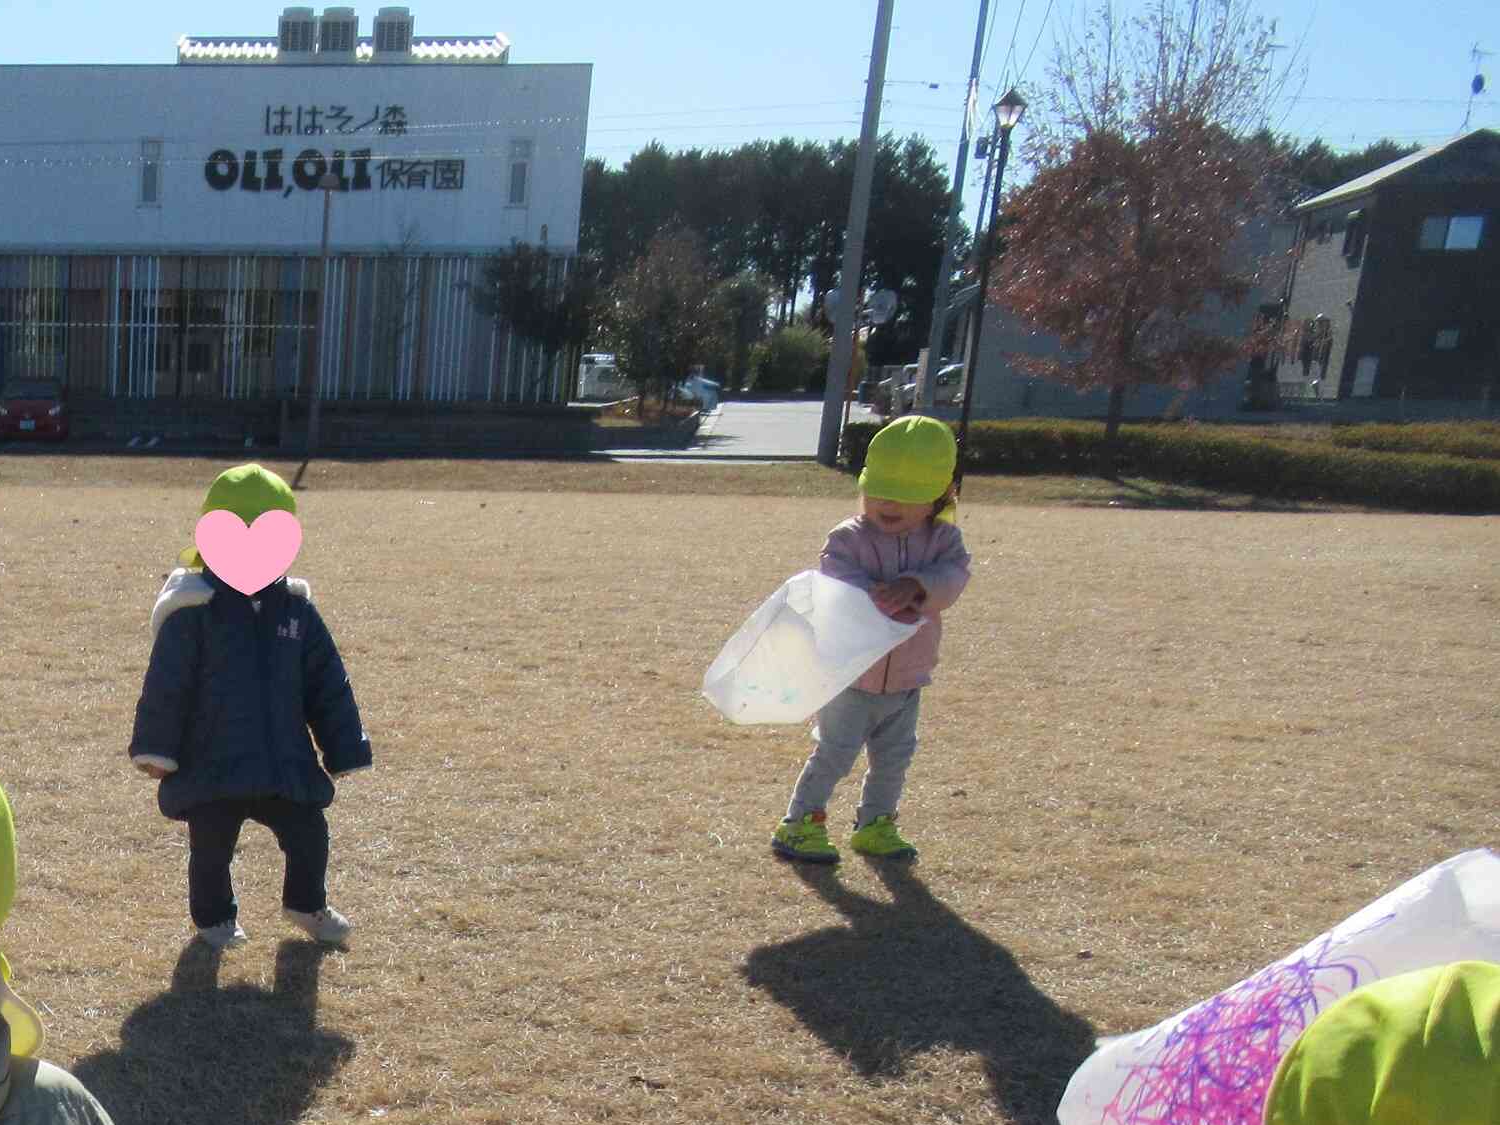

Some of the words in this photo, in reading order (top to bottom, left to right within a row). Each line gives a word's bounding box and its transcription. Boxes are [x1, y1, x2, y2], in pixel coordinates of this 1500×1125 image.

[265, 105, 408, 136] ははそノ森
[376, 158, 465, 190] 保育園
